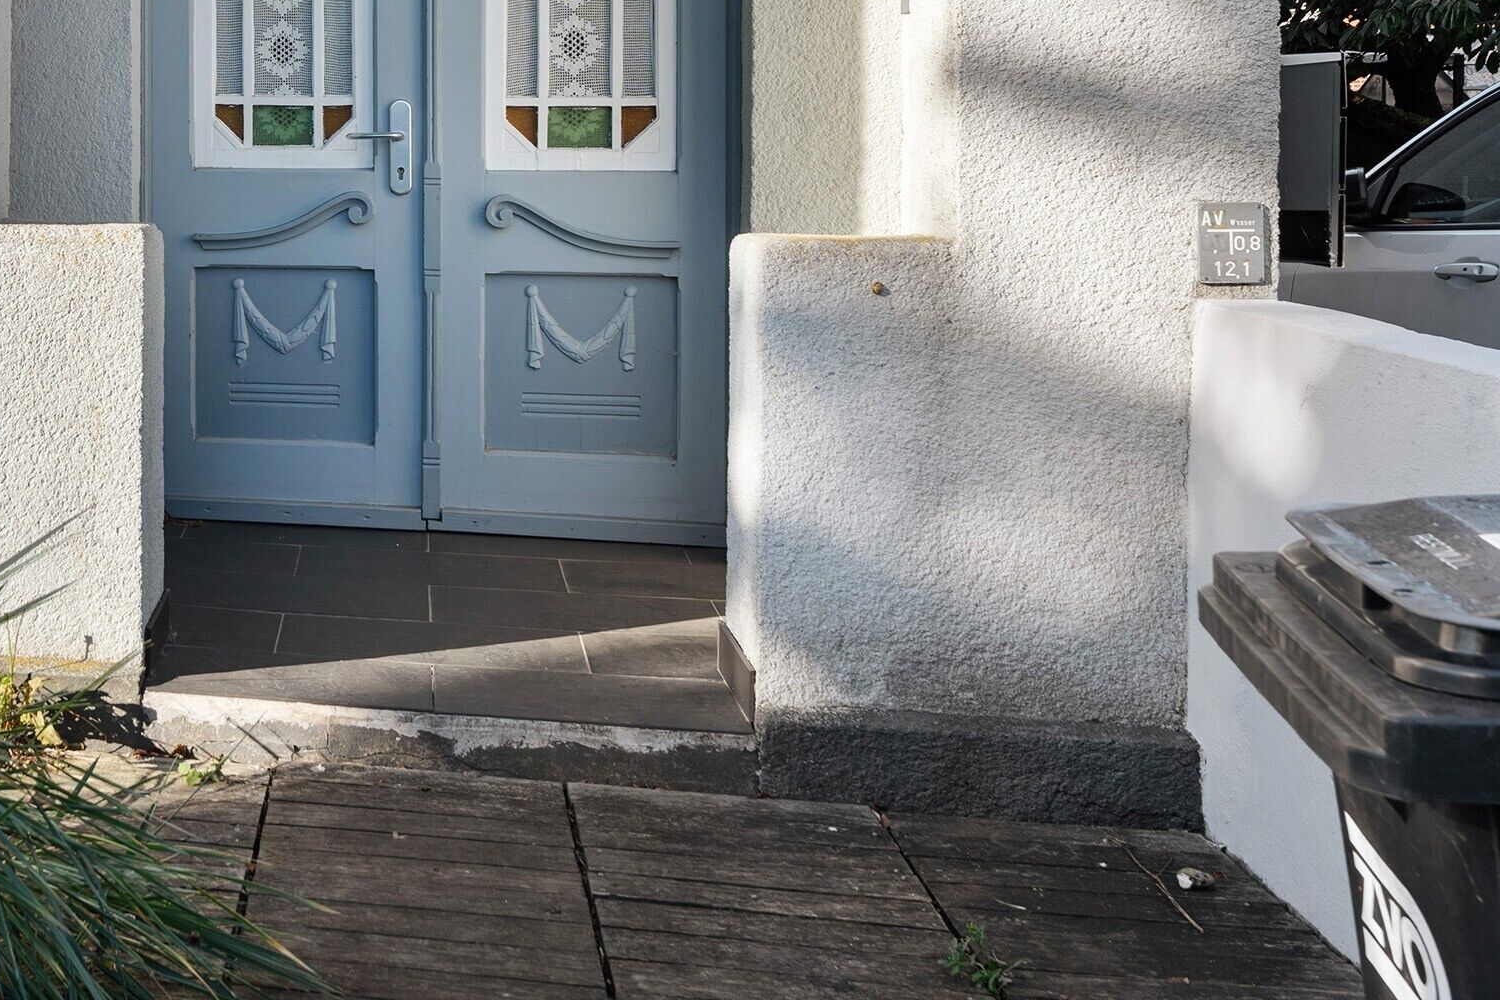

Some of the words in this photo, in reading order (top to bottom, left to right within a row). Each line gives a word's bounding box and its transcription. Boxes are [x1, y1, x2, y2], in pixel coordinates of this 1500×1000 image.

[1201, 210, 1224, 227] AV
[1229, 218, 1257, 226] Wasser
[1233, 235, 1261, 254] 0,8
[1214, 260, 1250, 279] 12,1
